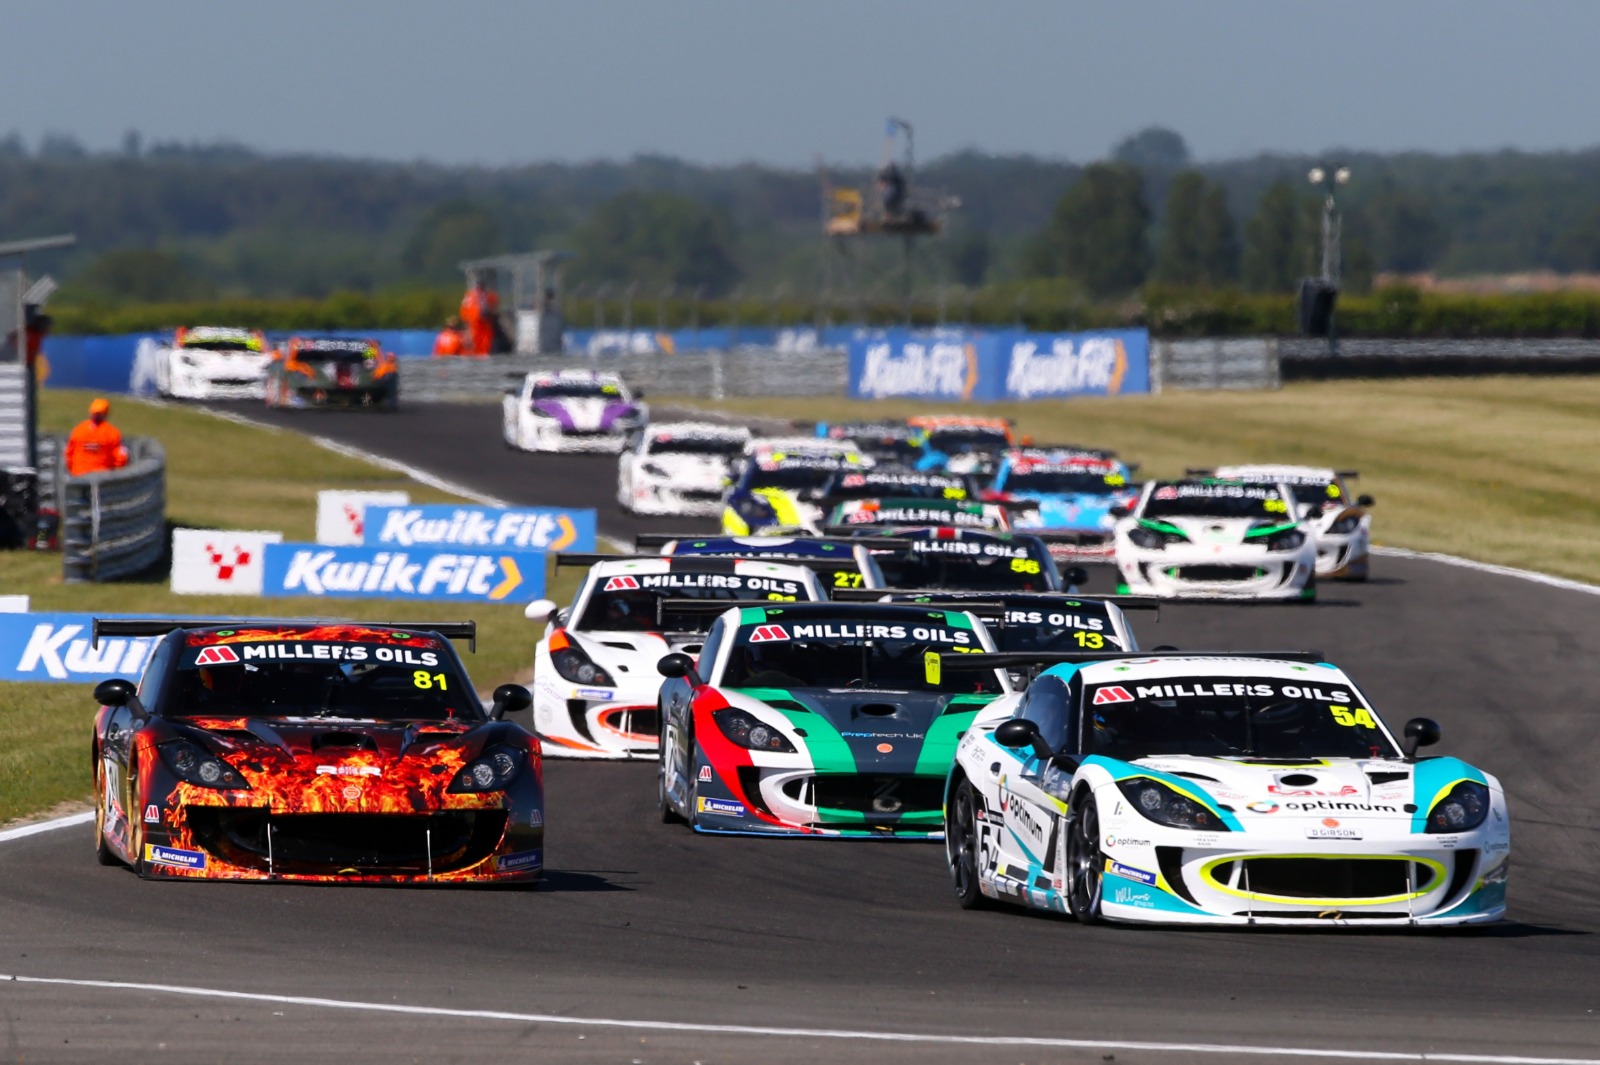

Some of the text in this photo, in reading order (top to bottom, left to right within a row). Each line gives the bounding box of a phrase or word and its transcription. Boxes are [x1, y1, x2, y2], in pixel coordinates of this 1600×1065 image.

[914, 540, 1028, 559] ILLERS OILS
[1010, 558, 1041, 574] 56
[643, 574, 798, 593] MILLERS OILS
[834, 572, 863, 588] 27
[1048, 613, 1103, 631] OILS
[793, 624, 970, 644] MILLERS OILS
[1073, 631, 1104, 649] 13
[243, 644, 438, 666] MILLERS OILS
[413, 670, 448, 691] 81
[1137, 683, 1350, 703] MILLERS OILS
[1329, 705, 1376, 729] 54
[712, 803, 745, 812] MICHELIN
[1286, 800, 1397, 812] optimum
[1010, 795, 1042, 844] optimum
[1117, 837, 1151, 847] optimum
[161, 852, 198, 864] MICHELIN
